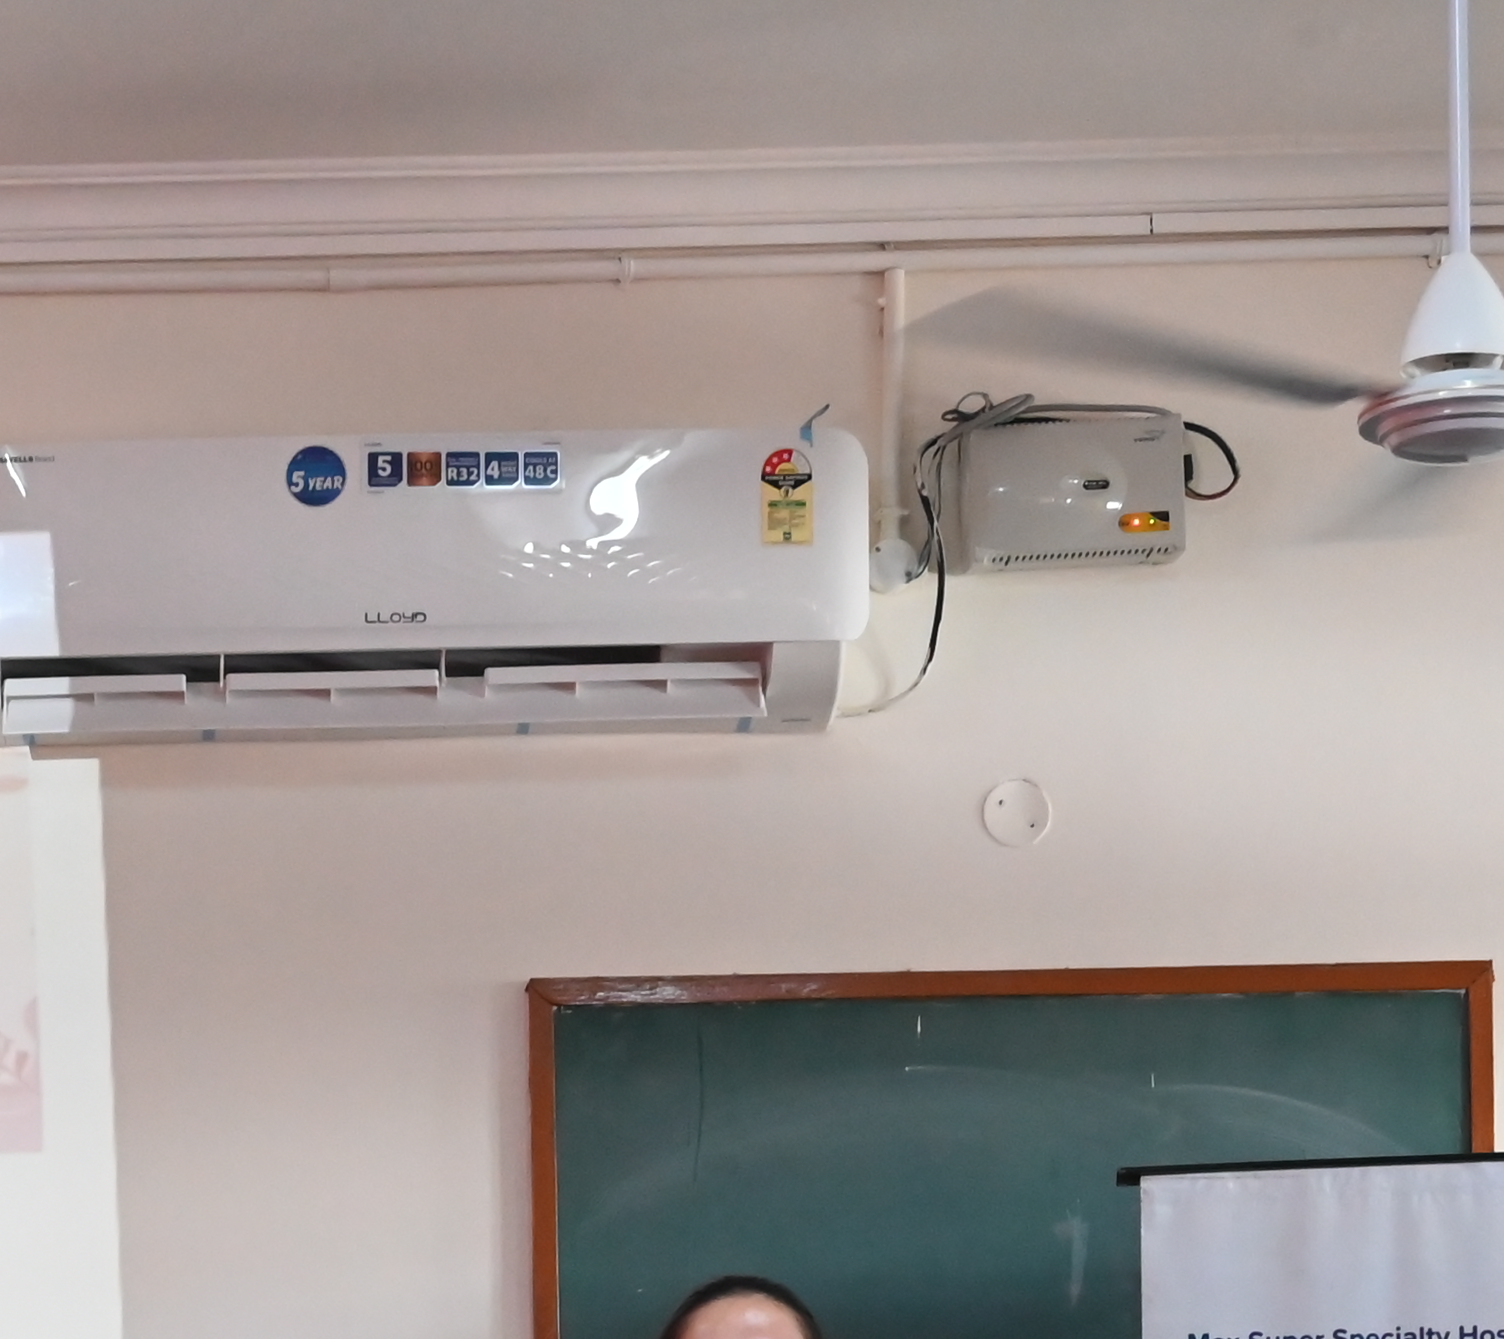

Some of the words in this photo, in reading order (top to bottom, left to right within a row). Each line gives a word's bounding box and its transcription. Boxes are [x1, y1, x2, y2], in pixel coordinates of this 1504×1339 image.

[377, 455, 392, 477] 5
[447, 467, 478, 481] R32
[486, 461, 500, 479] 4
[291, 471, 305, 493] 5
[308, 476, 343, 491] YEAR
[364, 611, 427, 624] LLOYD
